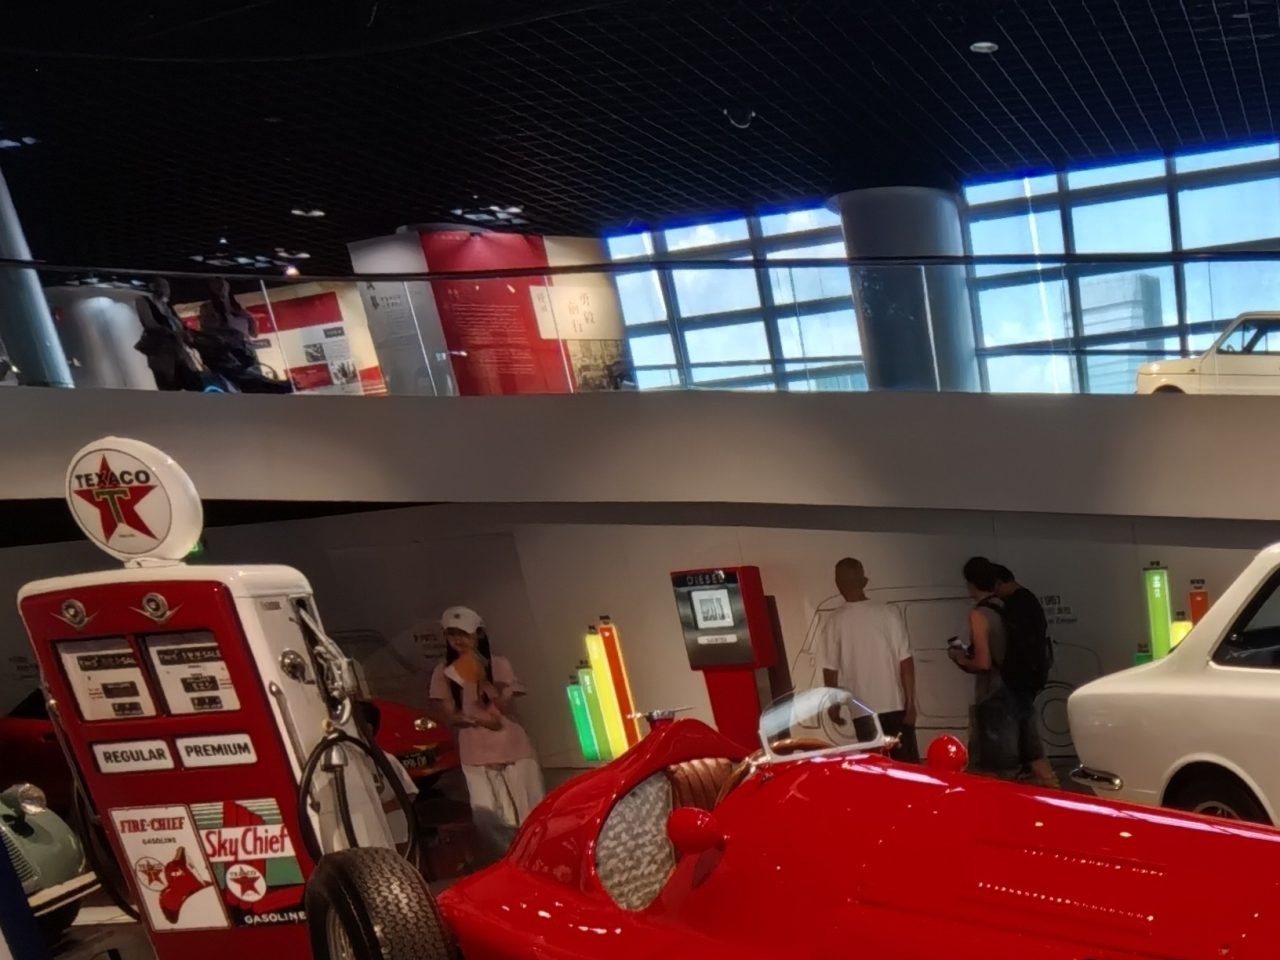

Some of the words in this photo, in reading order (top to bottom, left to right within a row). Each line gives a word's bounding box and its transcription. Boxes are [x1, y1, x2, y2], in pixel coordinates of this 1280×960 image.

[75, 470, 150, 488] TEXACO
[103, 748, 167, 764] REGULAR
[185, 742, 251, 758] PREMIUM
[120, 816, 185, 834] FIRE-CHIEF
[142, 837, 177, 845] GASOLINE
[205, 830, 239, 861] Sky
[241, 825, 289, 855] Chief
[244, 911, 307, 924] GASOLINE
